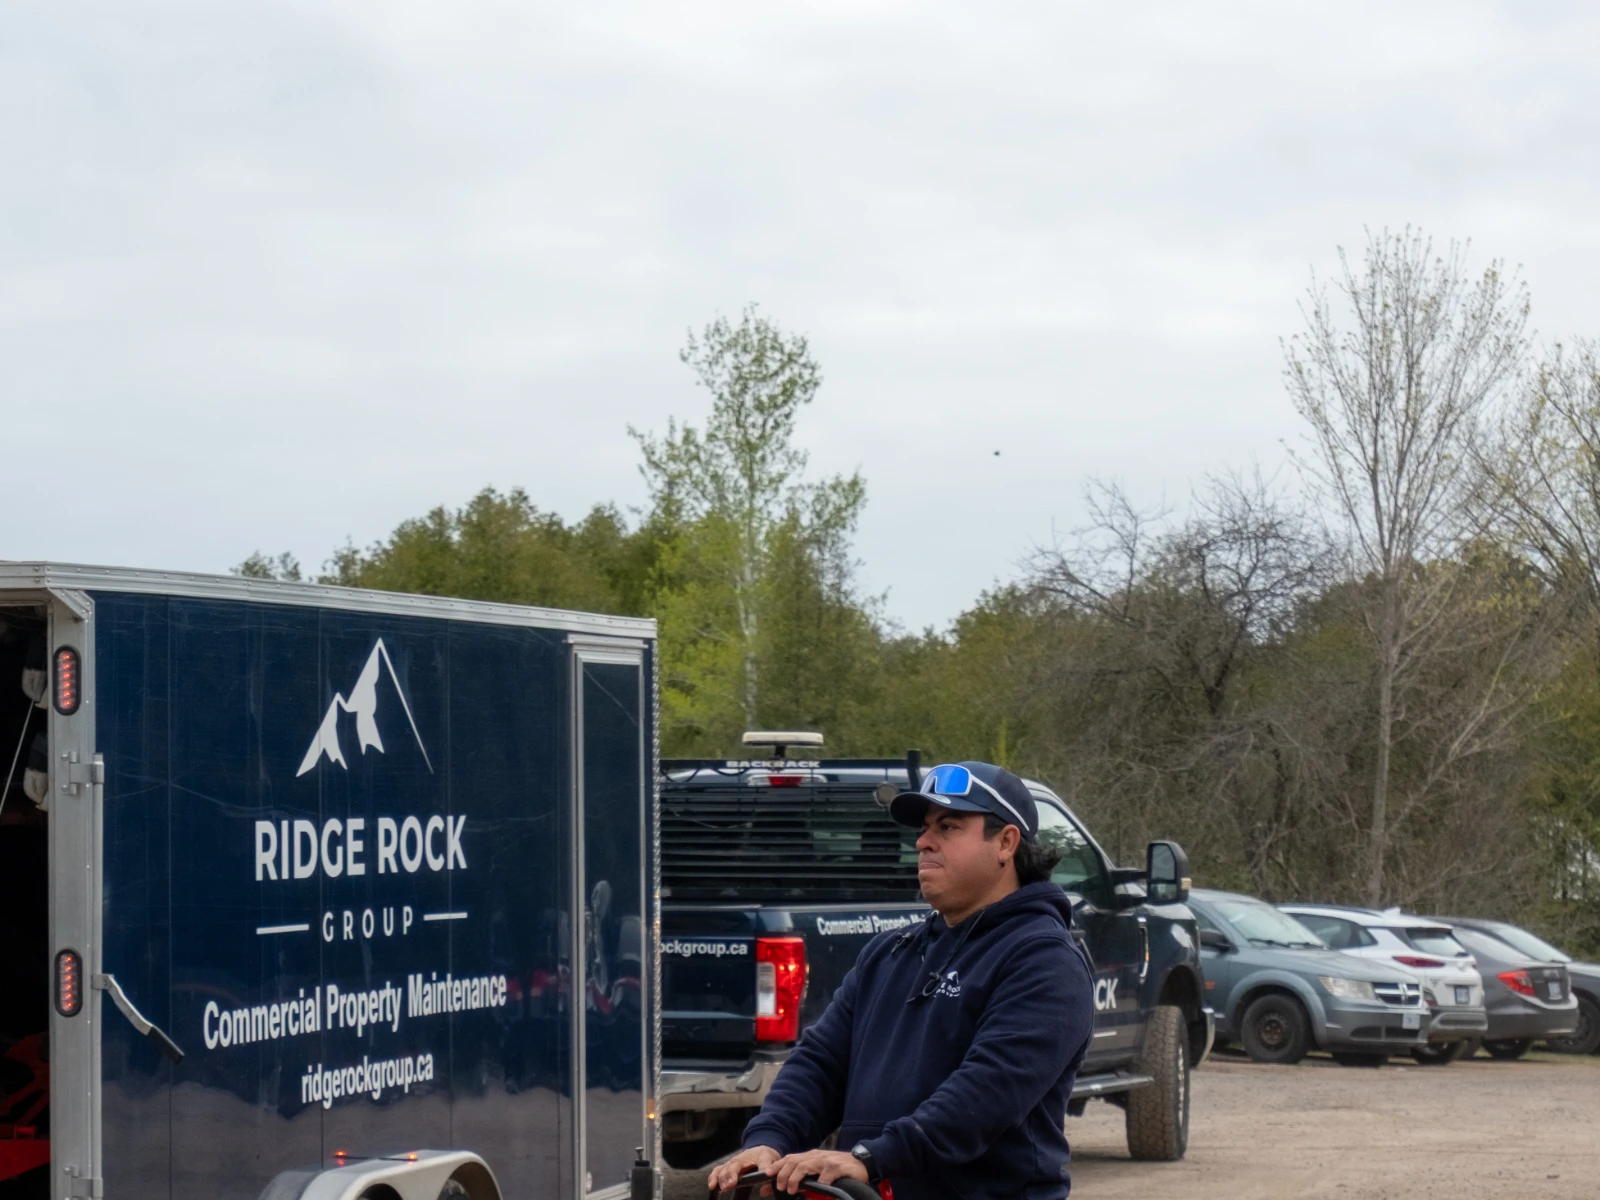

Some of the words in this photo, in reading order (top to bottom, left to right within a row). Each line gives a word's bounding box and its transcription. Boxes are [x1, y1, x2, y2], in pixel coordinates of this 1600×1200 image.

[726, 760, 820, 768] BACKRACK
[255, 818, 366, 881] RIDGE
[377, 815, 468, 874] ROCK
[322, 906, 414, 942] GROUP
[816, 916, 874, 935] Commercial
[203, 986, 321, 1050] Commercial
[326, 981, 402, 1038] Property
[408, 972, 507, 1018] Maintenance
[1093, 977, 1119, 1011] CK
[301, 1053, 434, 1109] ridgerockgroup.ca
